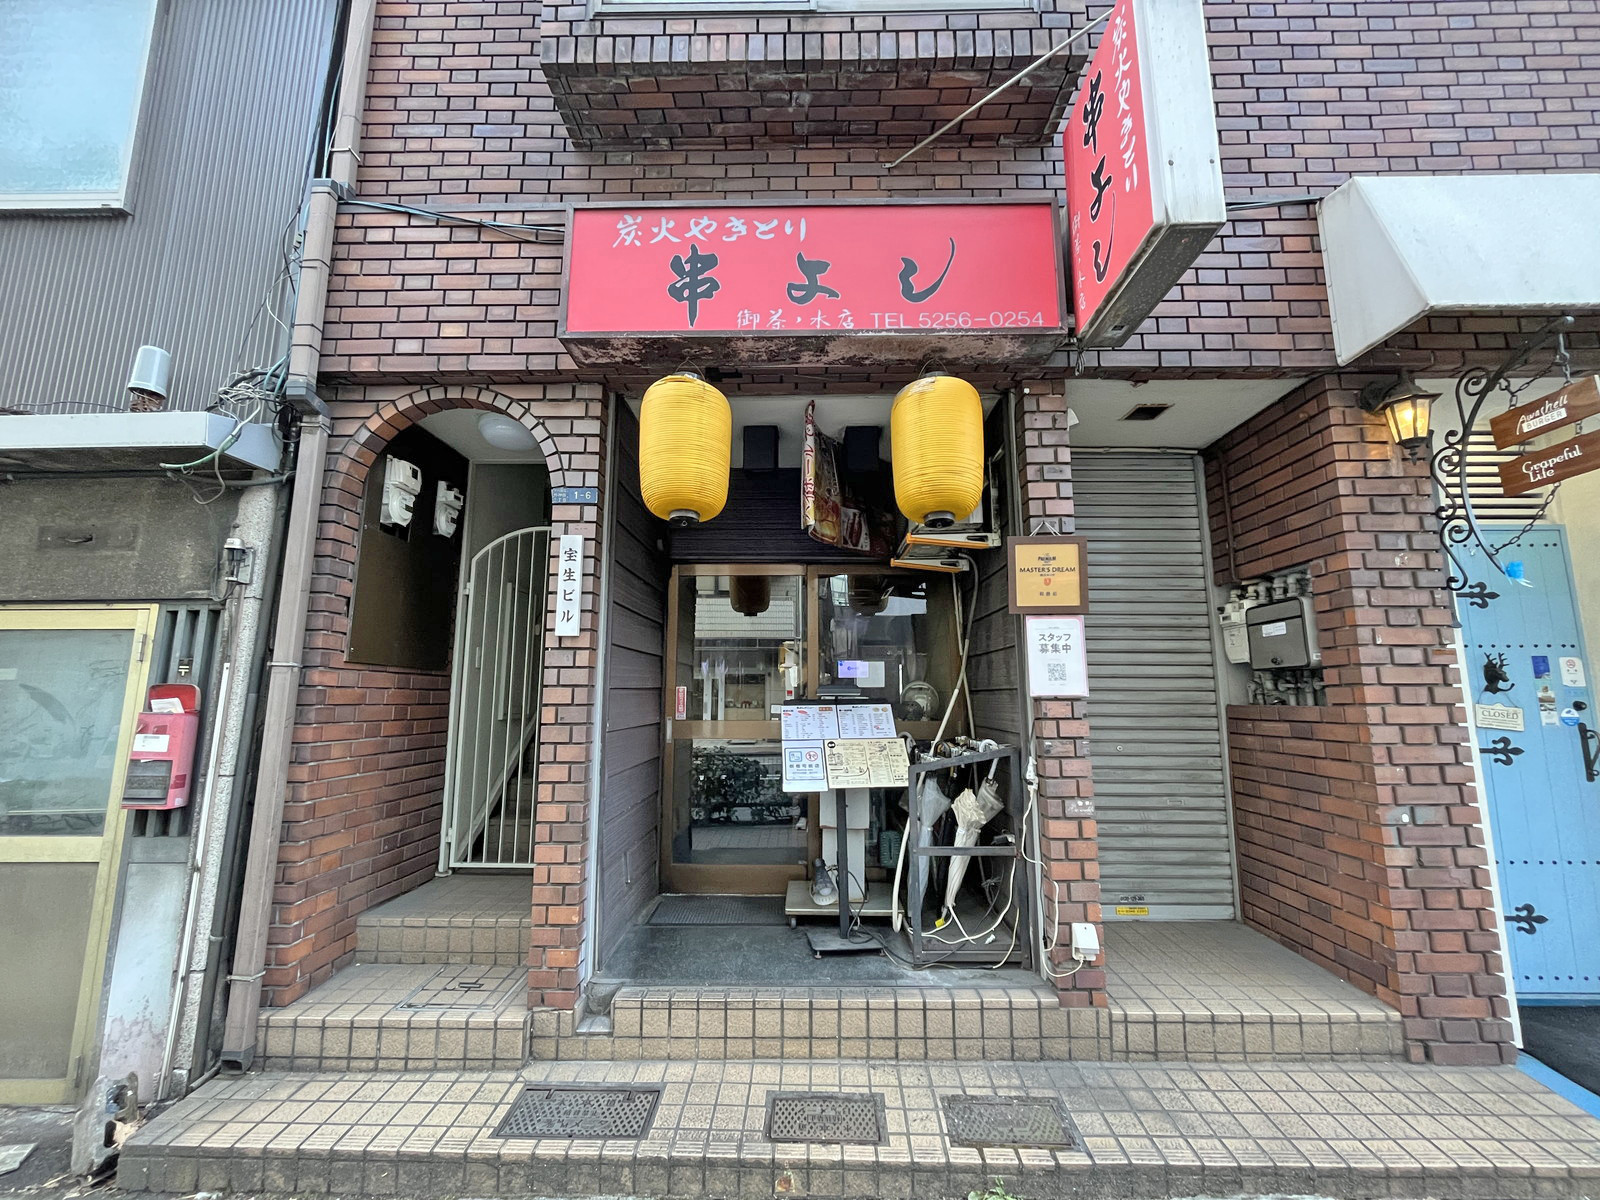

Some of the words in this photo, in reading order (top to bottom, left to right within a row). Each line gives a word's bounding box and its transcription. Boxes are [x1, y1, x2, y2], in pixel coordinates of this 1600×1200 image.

[1112, 4, 1138, 193] 炭火やきとり
[1082, 68, 1116, 284] 串よし
[612, 214, 807, 248] 炭火やきとり
[667, 237, 956, 329] 串よし
[870, 312, 912, 329] TEL
[918, 311, 1044, 329] 5256-0254
[1526, 410, 1563, 430] BURGER
[1522, 444, 1583, 474] Grapeful
[1529, 468, 1555, 482] Life
[574, 491, 592, 500] 1-6
[561, 548, 577, 623] 宝生ビル
[1038, 633, 1072, 642] スタッフ
[1039, 643, 1072, 654] 募集中
[1482, 709, 1518, 720] CLOSED
